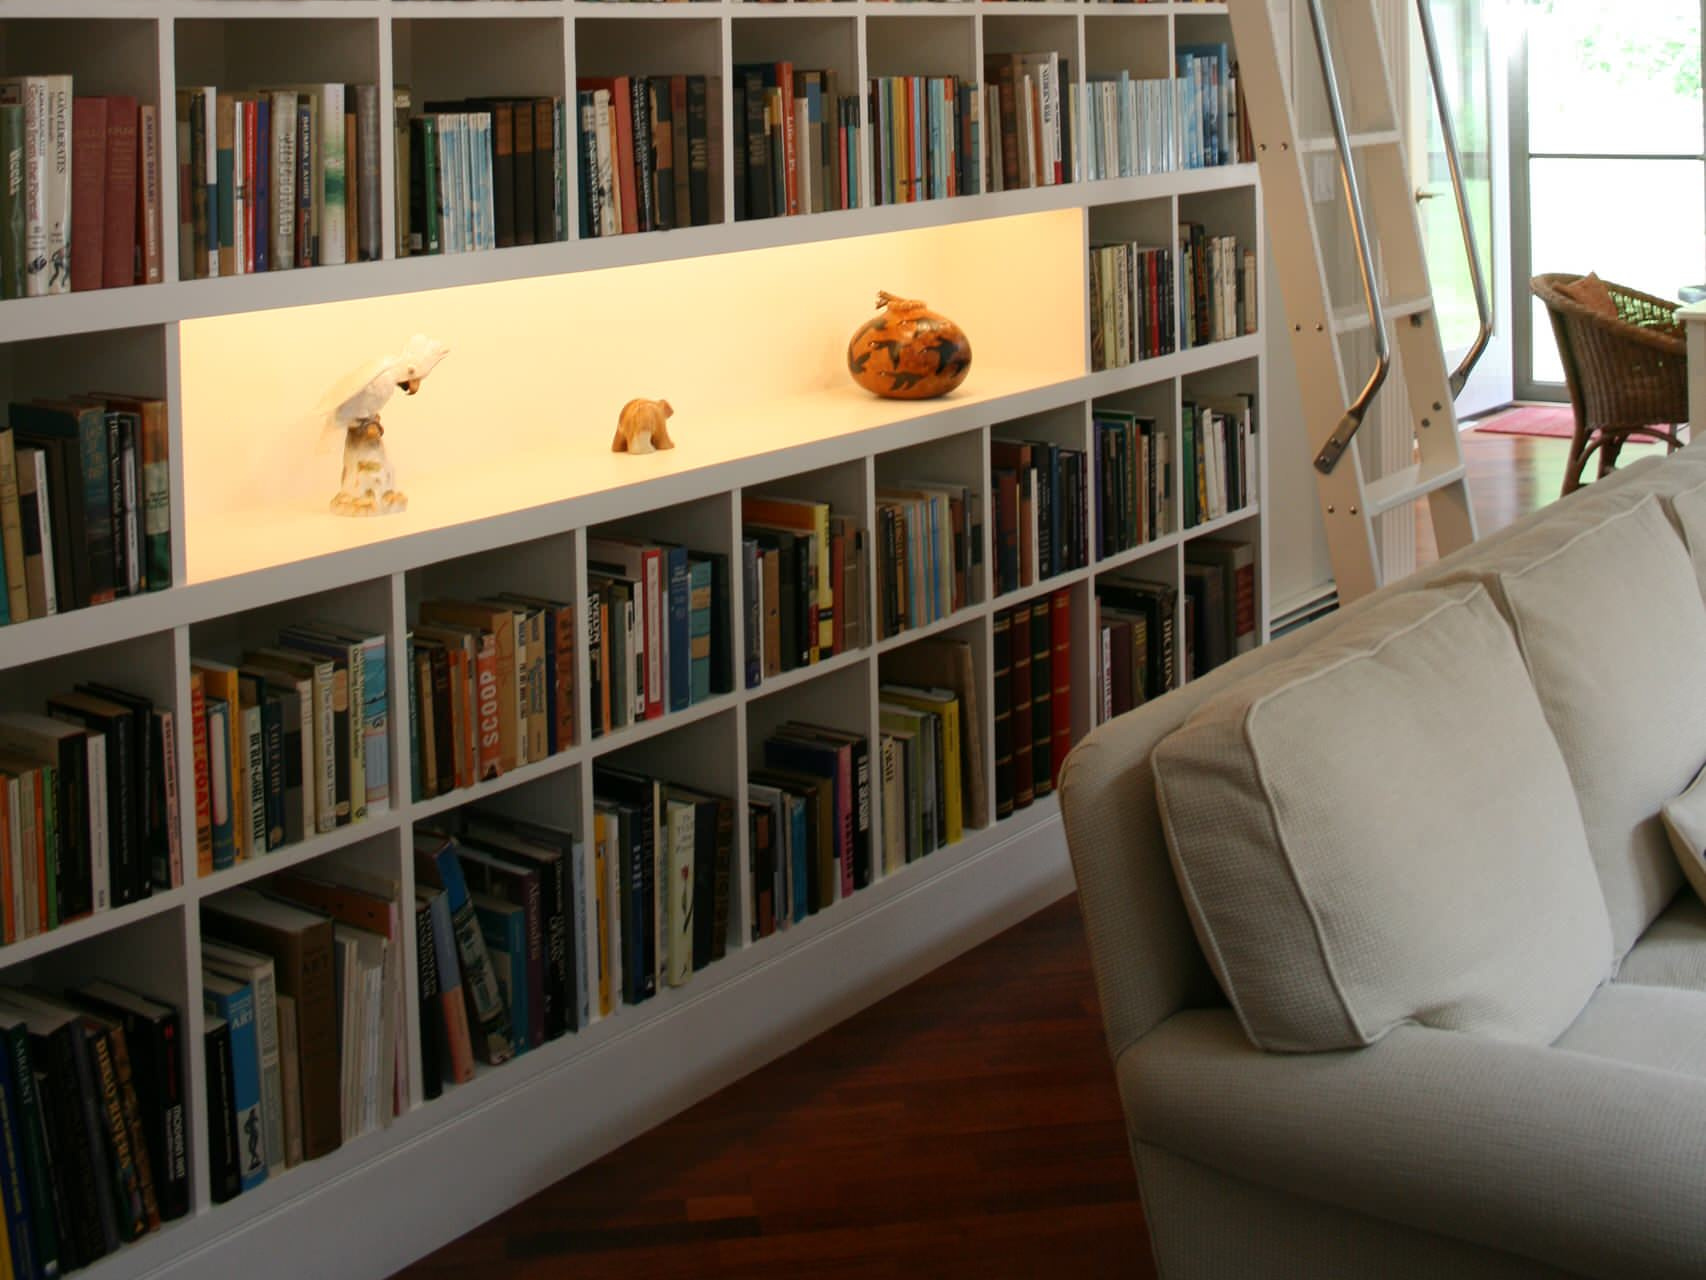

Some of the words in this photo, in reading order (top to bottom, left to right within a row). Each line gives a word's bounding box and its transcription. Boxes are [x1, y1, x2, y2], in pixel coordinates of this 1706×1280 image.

[25, 83, 38, 127] Gossip
[27, 128, 38, 160] from
[56, 90, 66, 175] CONFEDERATES
[279, 135, 293, 163] THE
[28, 161, 39, 182] the
[28, 183, 39, 223] Forest
[279, 166, 293, 236] LEOPARD
[592, 593, 601, 644] EVELYN
[1163, 618, 1173, 688] DICTION
[479, 670, 499, 747] SCOOP
[95, 1038, 116, 1099] DIEGO
[107, 1103, 131, 1169] RIVERA
